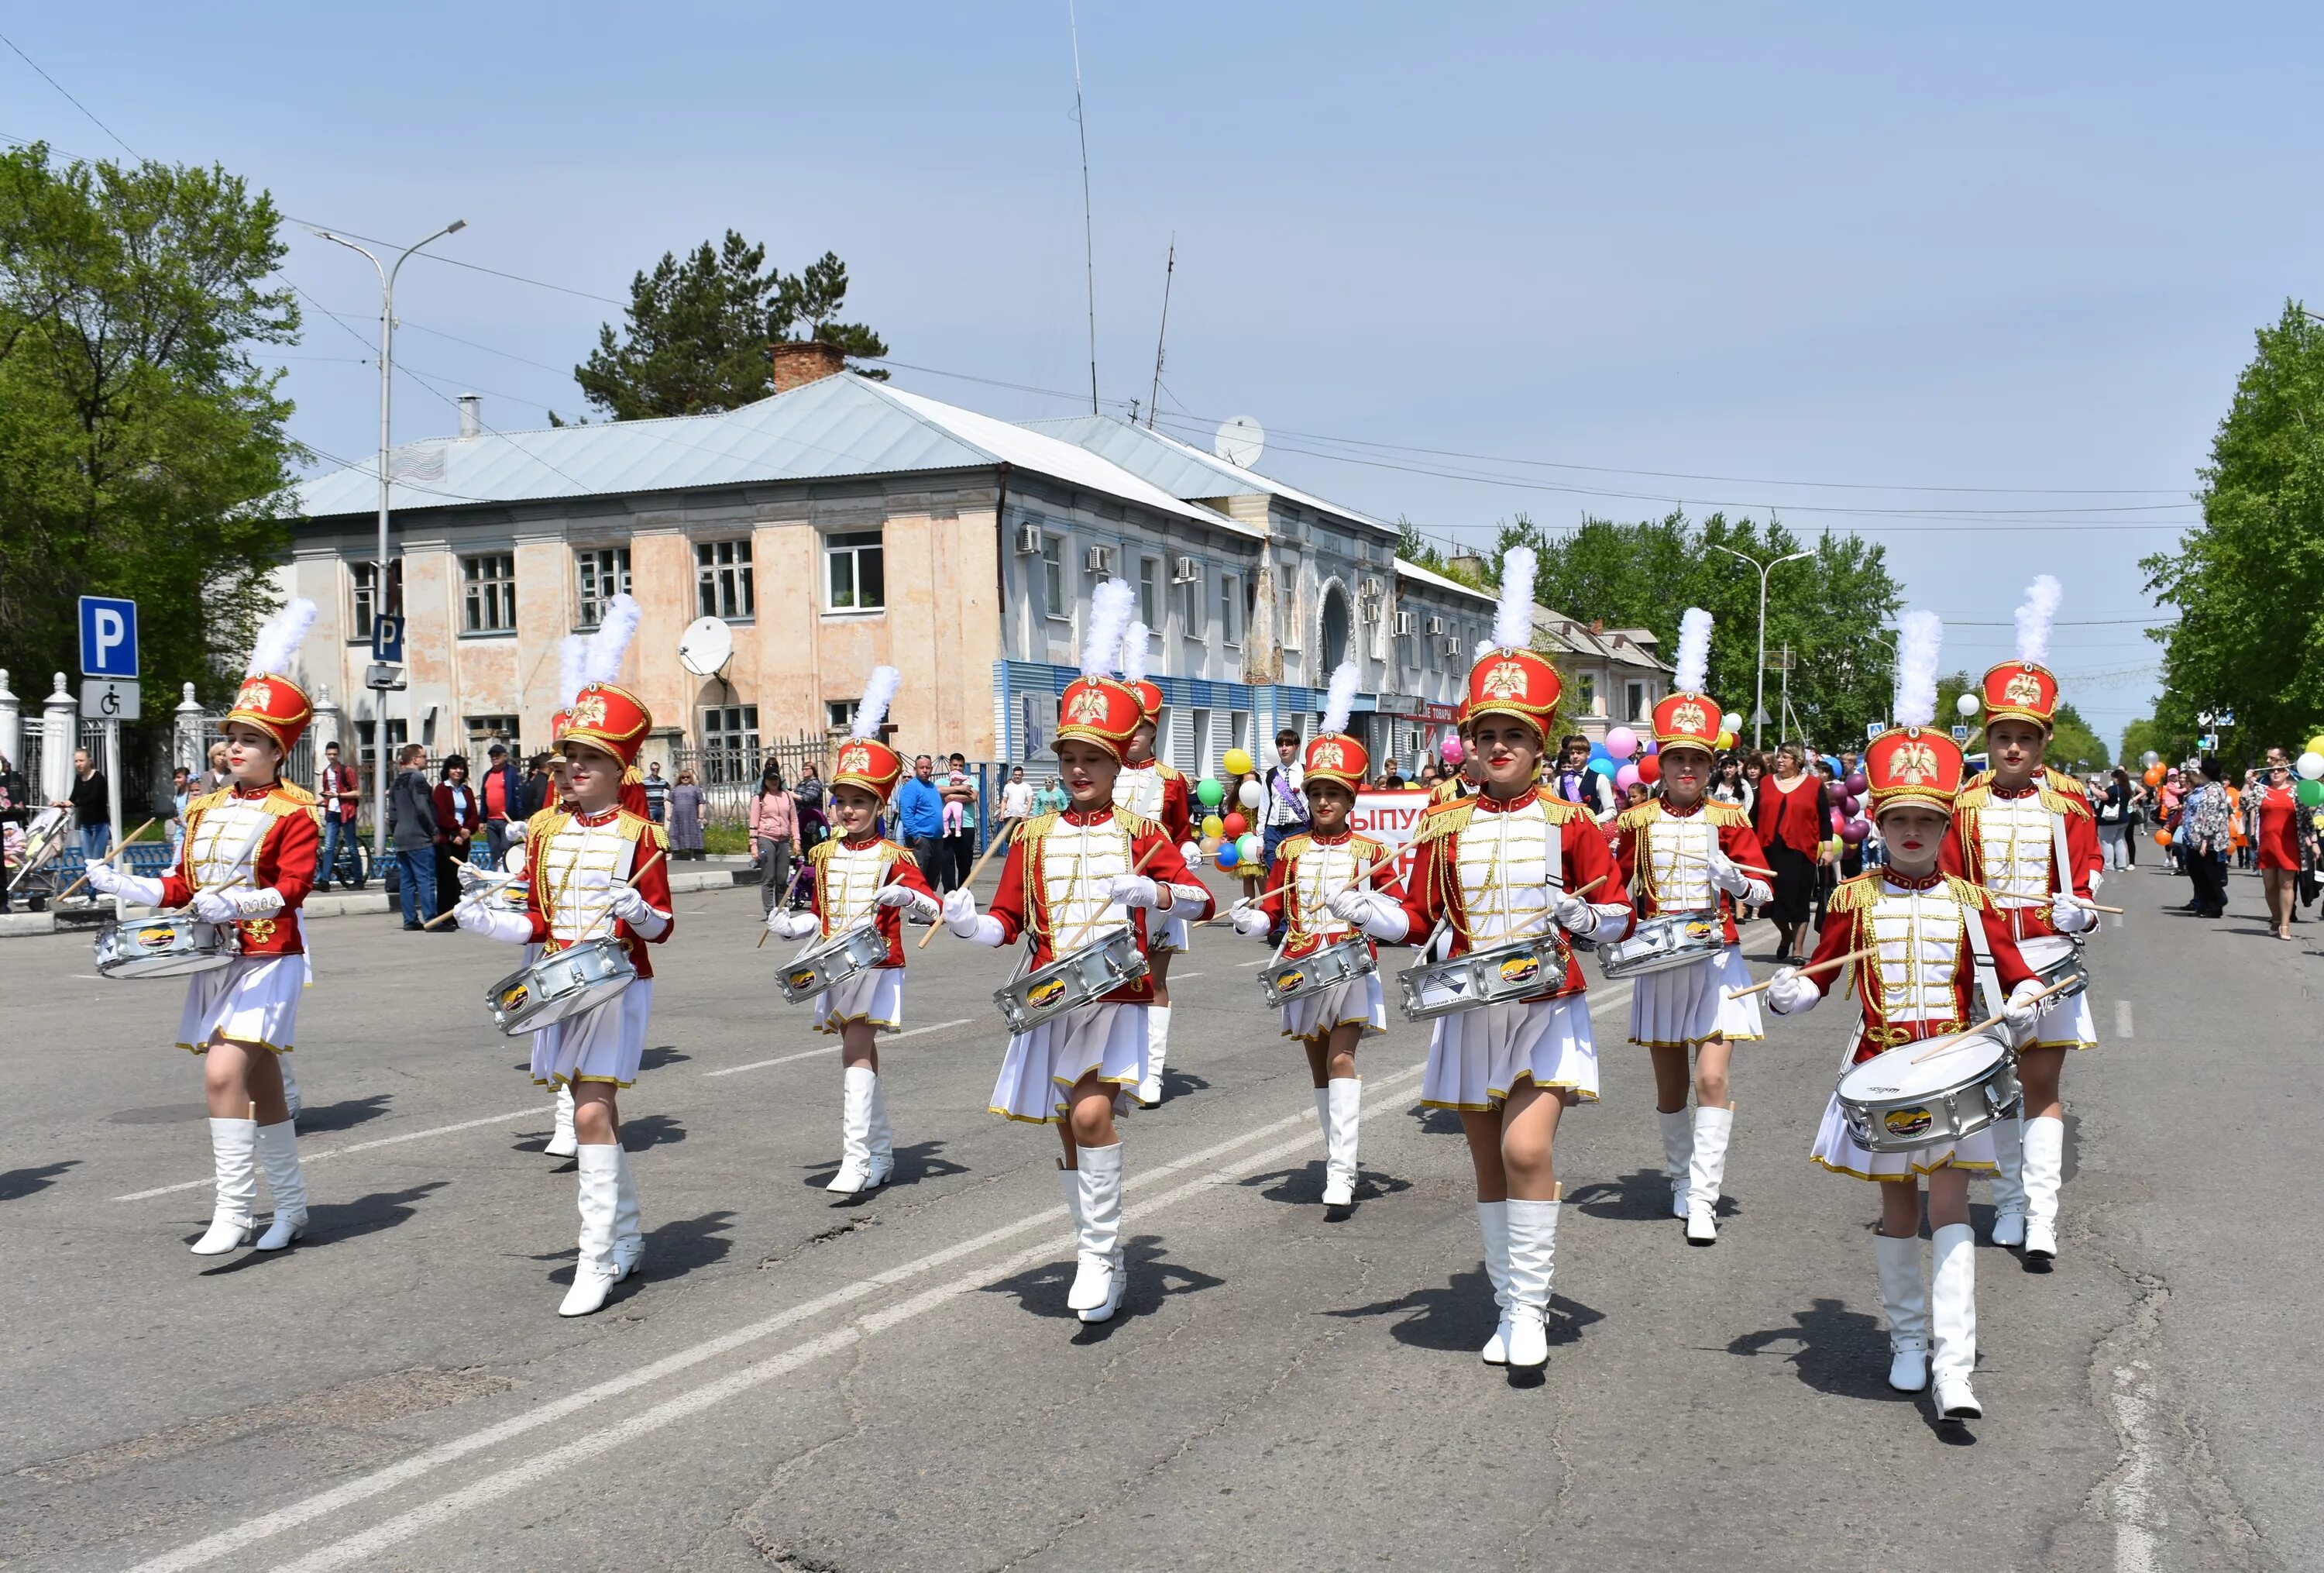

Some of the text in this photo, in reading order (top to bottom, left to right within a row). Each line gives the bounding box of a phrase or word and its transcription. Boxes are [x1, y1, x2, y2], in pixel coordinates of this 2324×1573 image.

[95, 608, 124, 668] P
[379, 620, 397, 655] P
[1432, 707, 1452, 720] ТОВАРЫ
[1349, 808, 1428, 831] ЫПУ
[1424, 1000, 1449, 1009] РУССКИЙ
